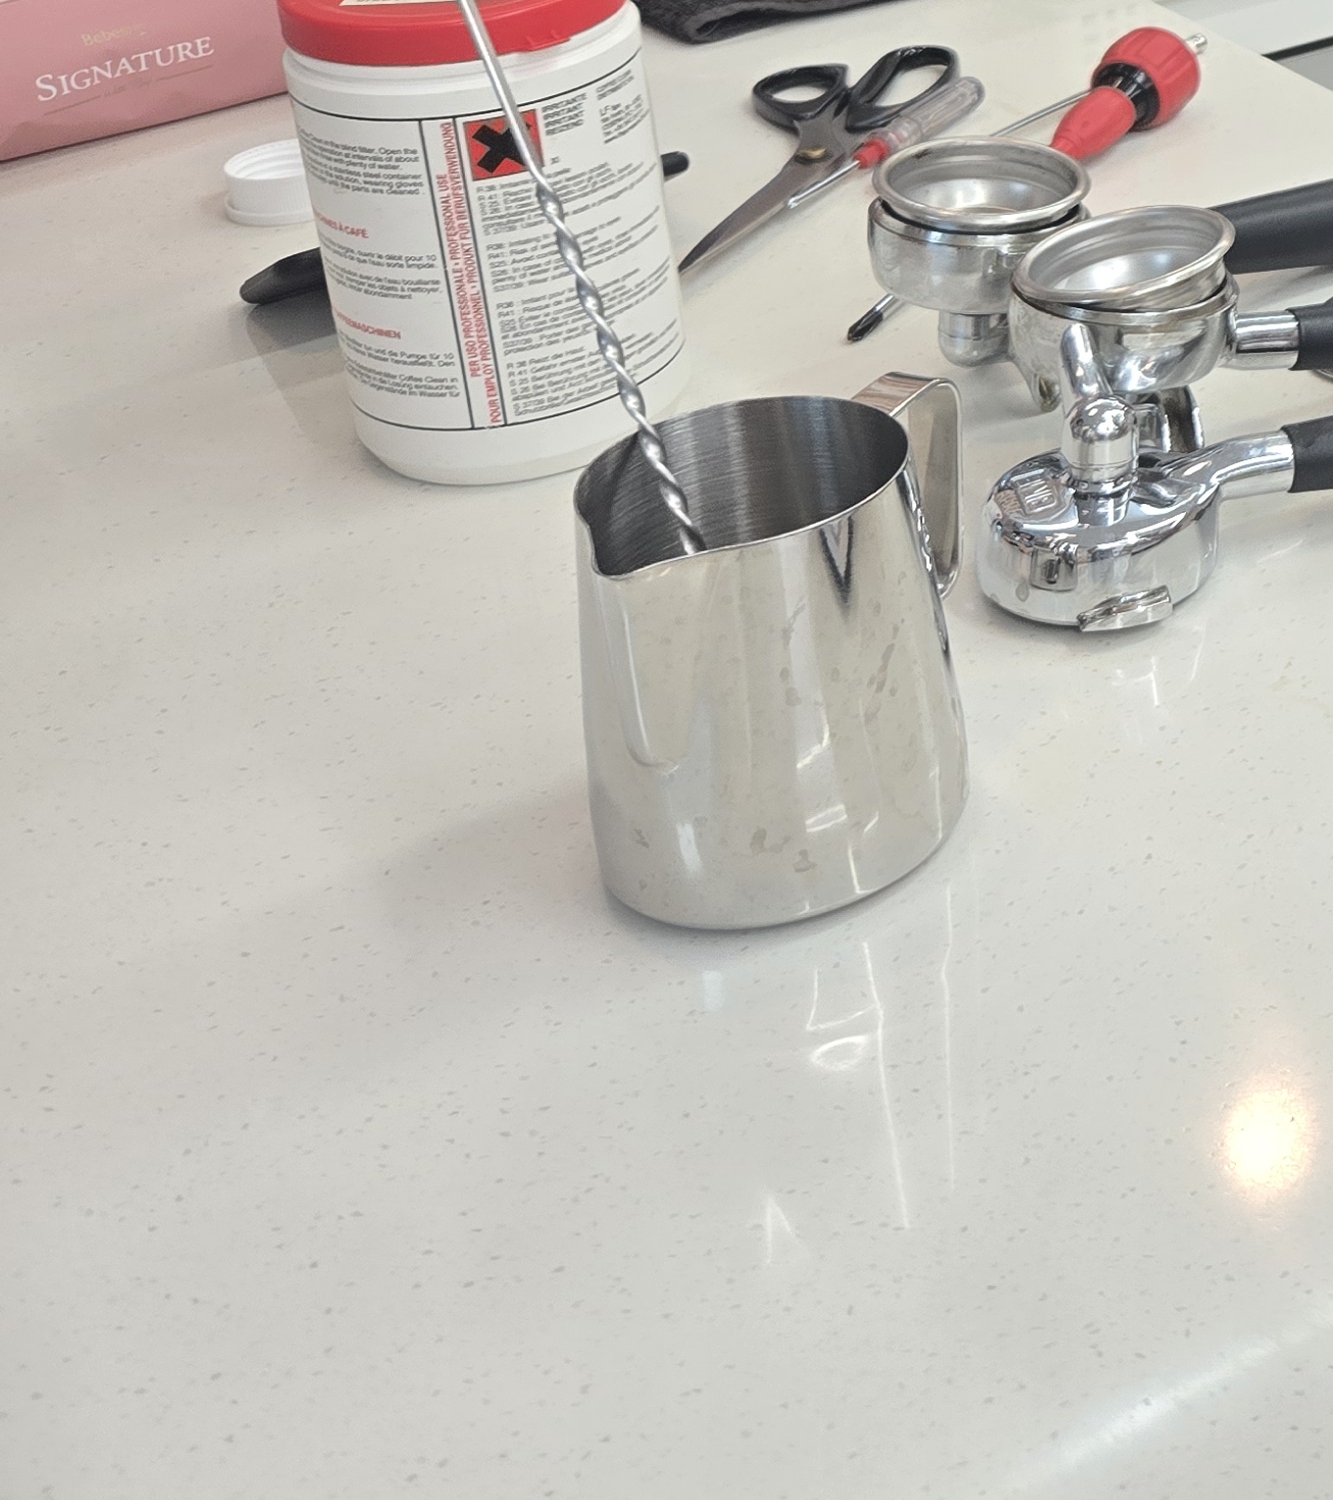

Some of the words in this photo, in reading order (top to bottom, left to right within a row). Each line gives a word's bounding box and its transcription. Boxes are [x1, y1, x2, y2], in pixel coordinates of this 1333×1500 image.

[35, 35, 215, 102] SIGNATURE
[378, 147, 402, 156] Open
[436, 174, 450, 192] USE
[440, 194, 461, 261] PROFESSIONAL
